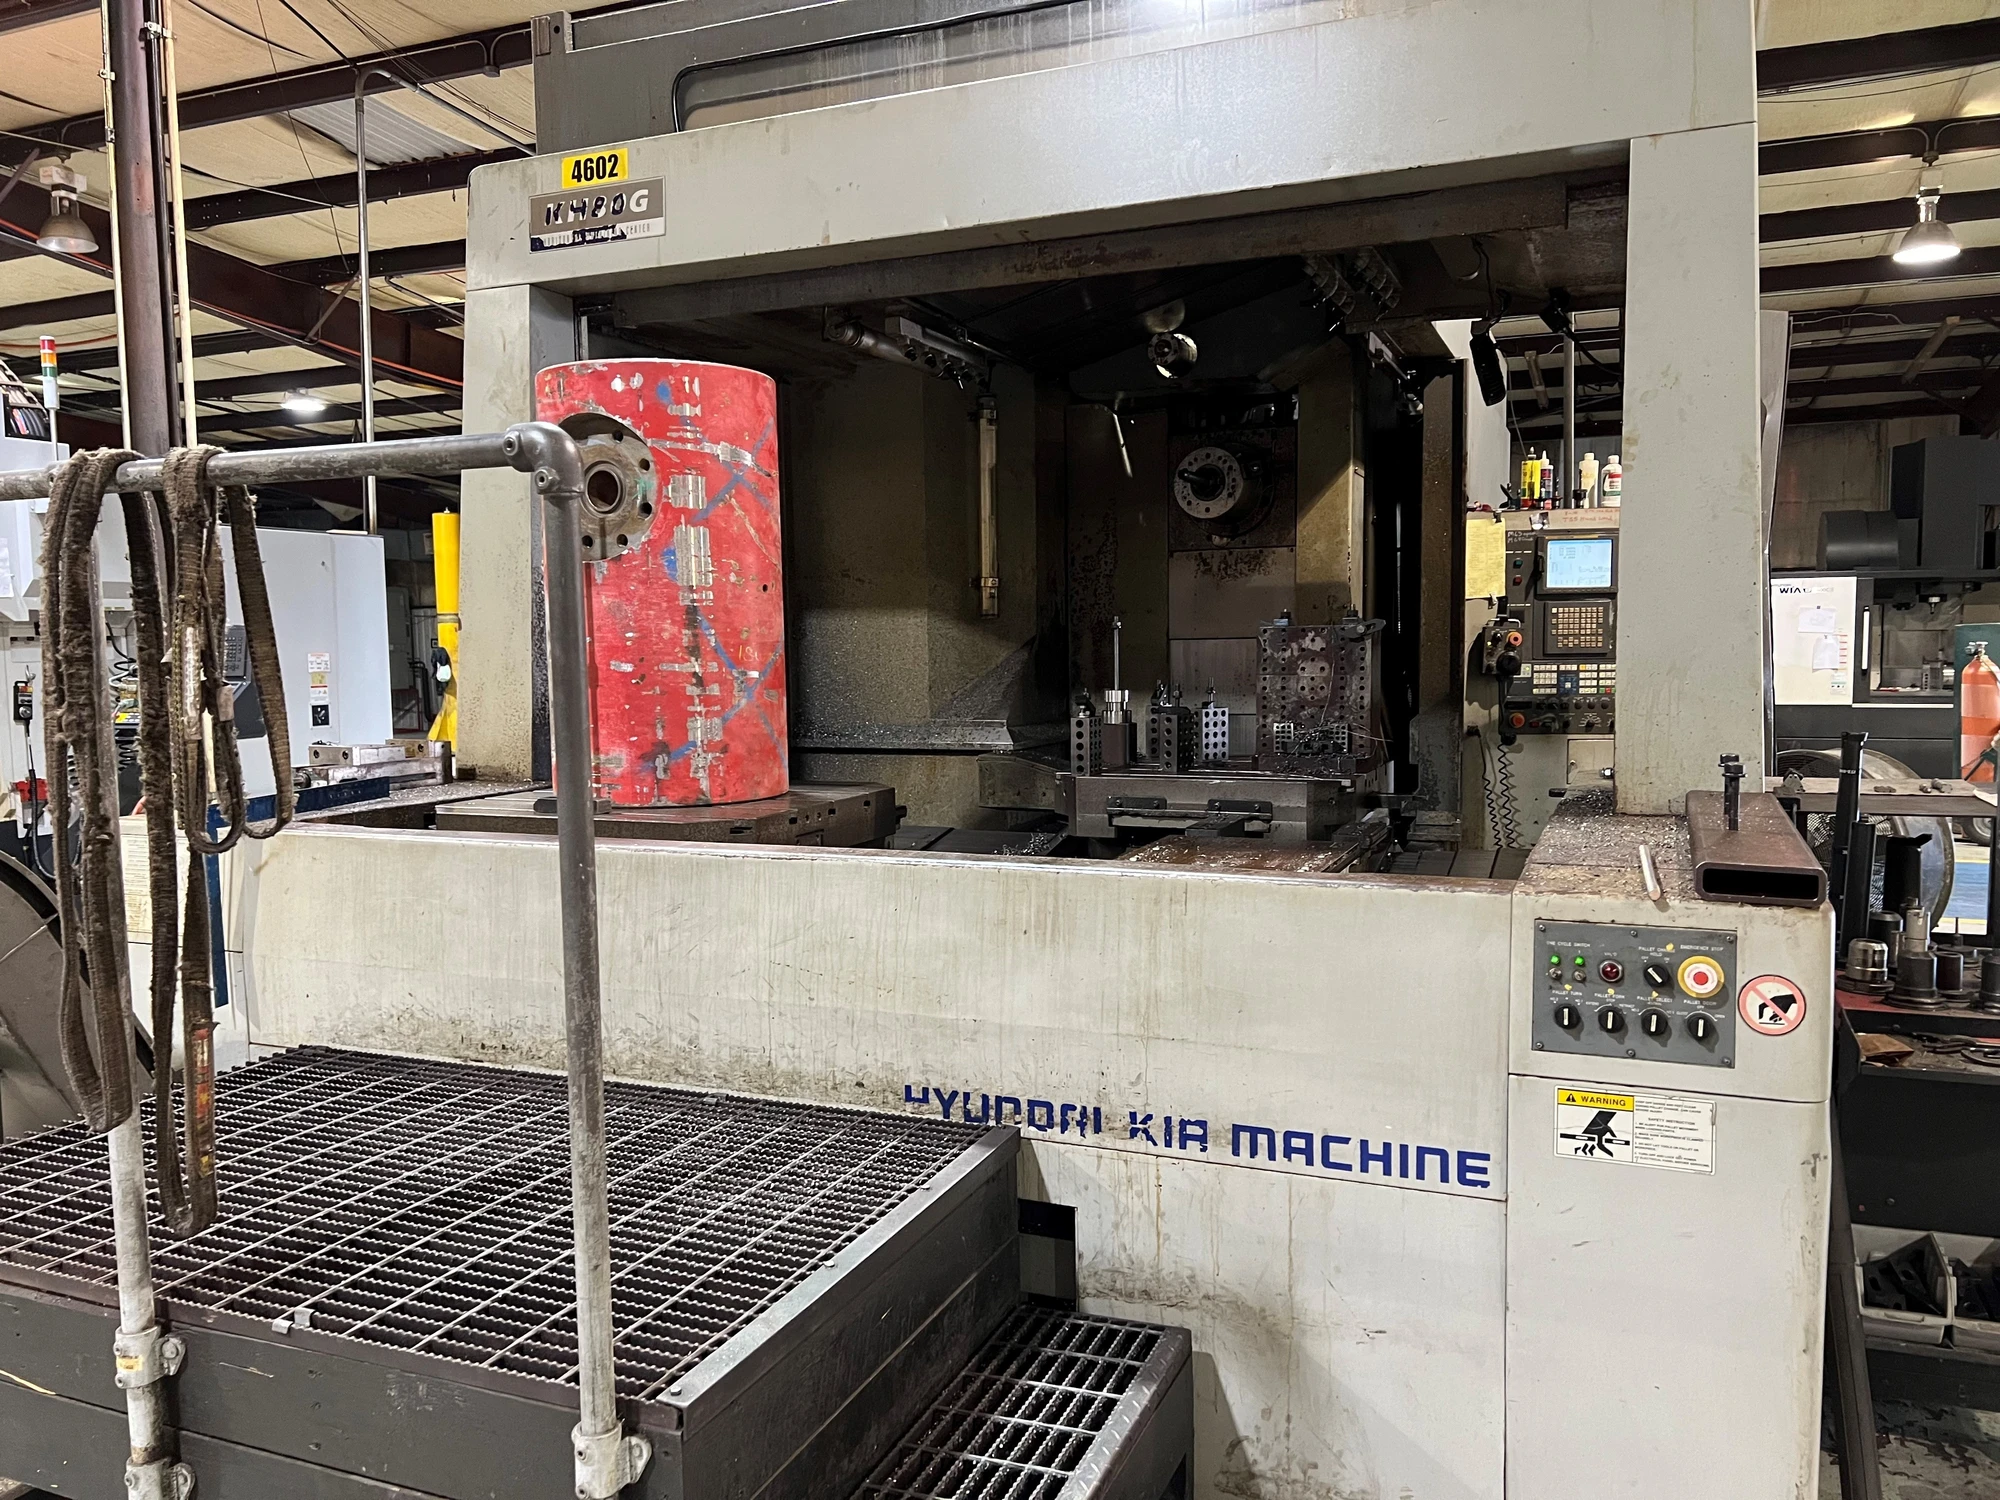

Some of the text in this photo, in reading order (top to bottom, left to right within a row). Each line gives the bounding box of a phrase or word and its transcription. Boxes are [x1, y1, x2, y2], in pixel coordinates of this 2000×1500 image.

[571, 153, 619, 183] 4602
[1580, 1095, 1626, 1107] WARNING
[1128, 1110, 1209, 1153] KIA
[1231, 1123, 1491, 1189] MACHINE
